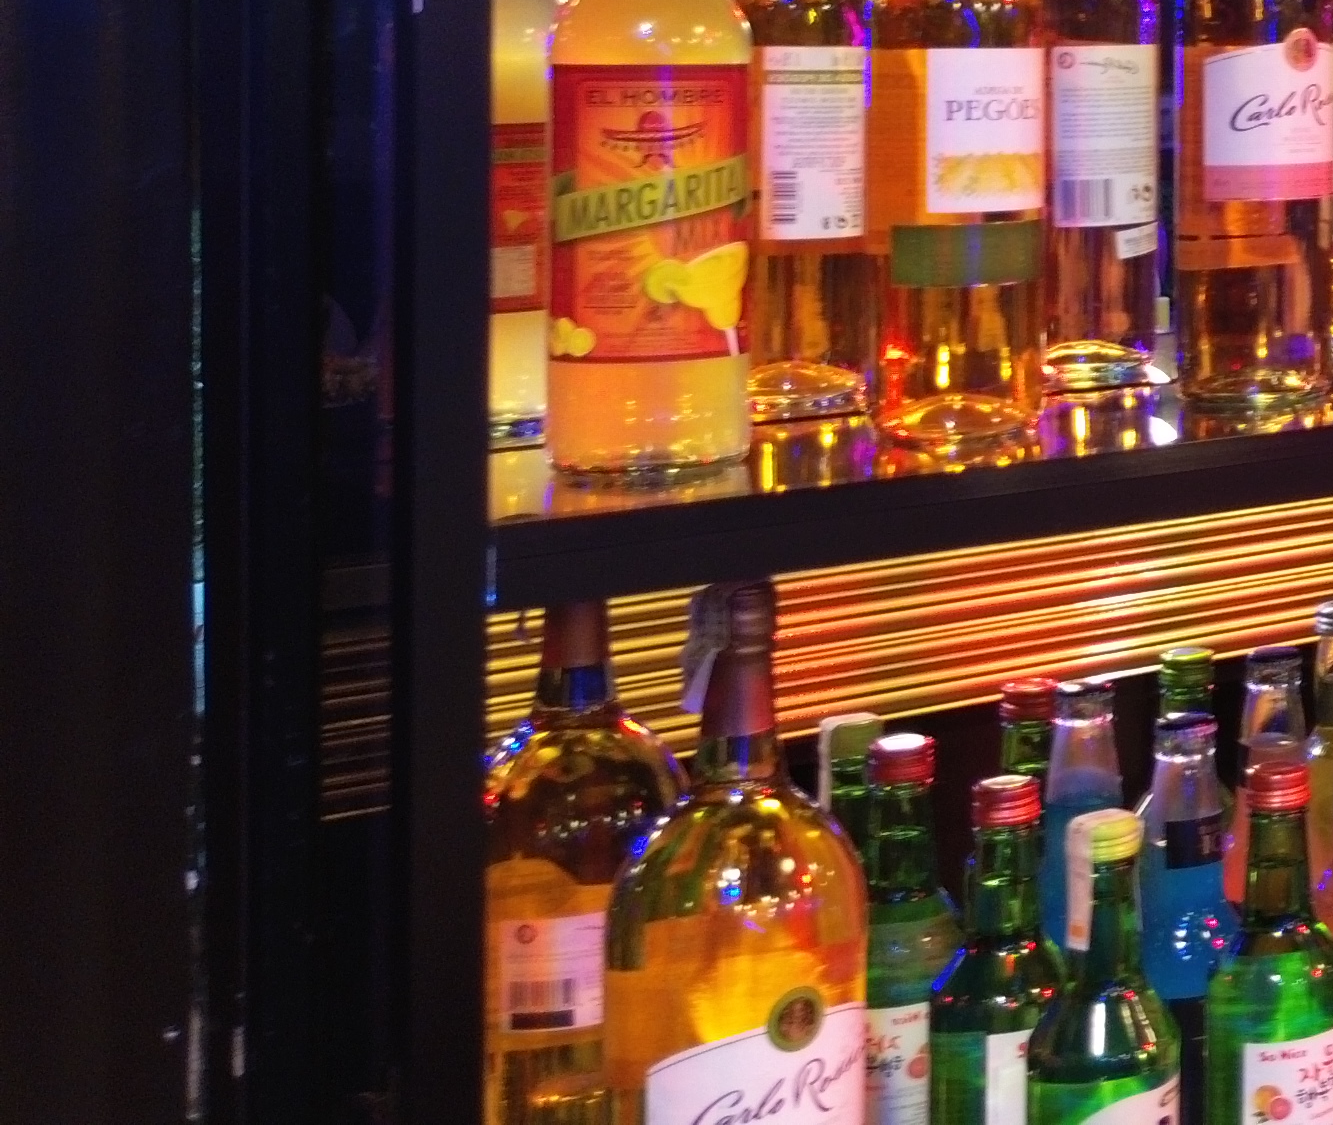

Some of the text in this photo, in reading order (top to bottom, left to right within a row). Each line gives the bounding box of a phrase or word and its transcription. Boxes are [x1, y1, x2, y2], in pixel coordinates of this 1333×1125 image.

[587, 89, 613, 105] EL
[1229, 90, 1298, 132] Carlo
[568, 165, 744, 231] MARGARITA
